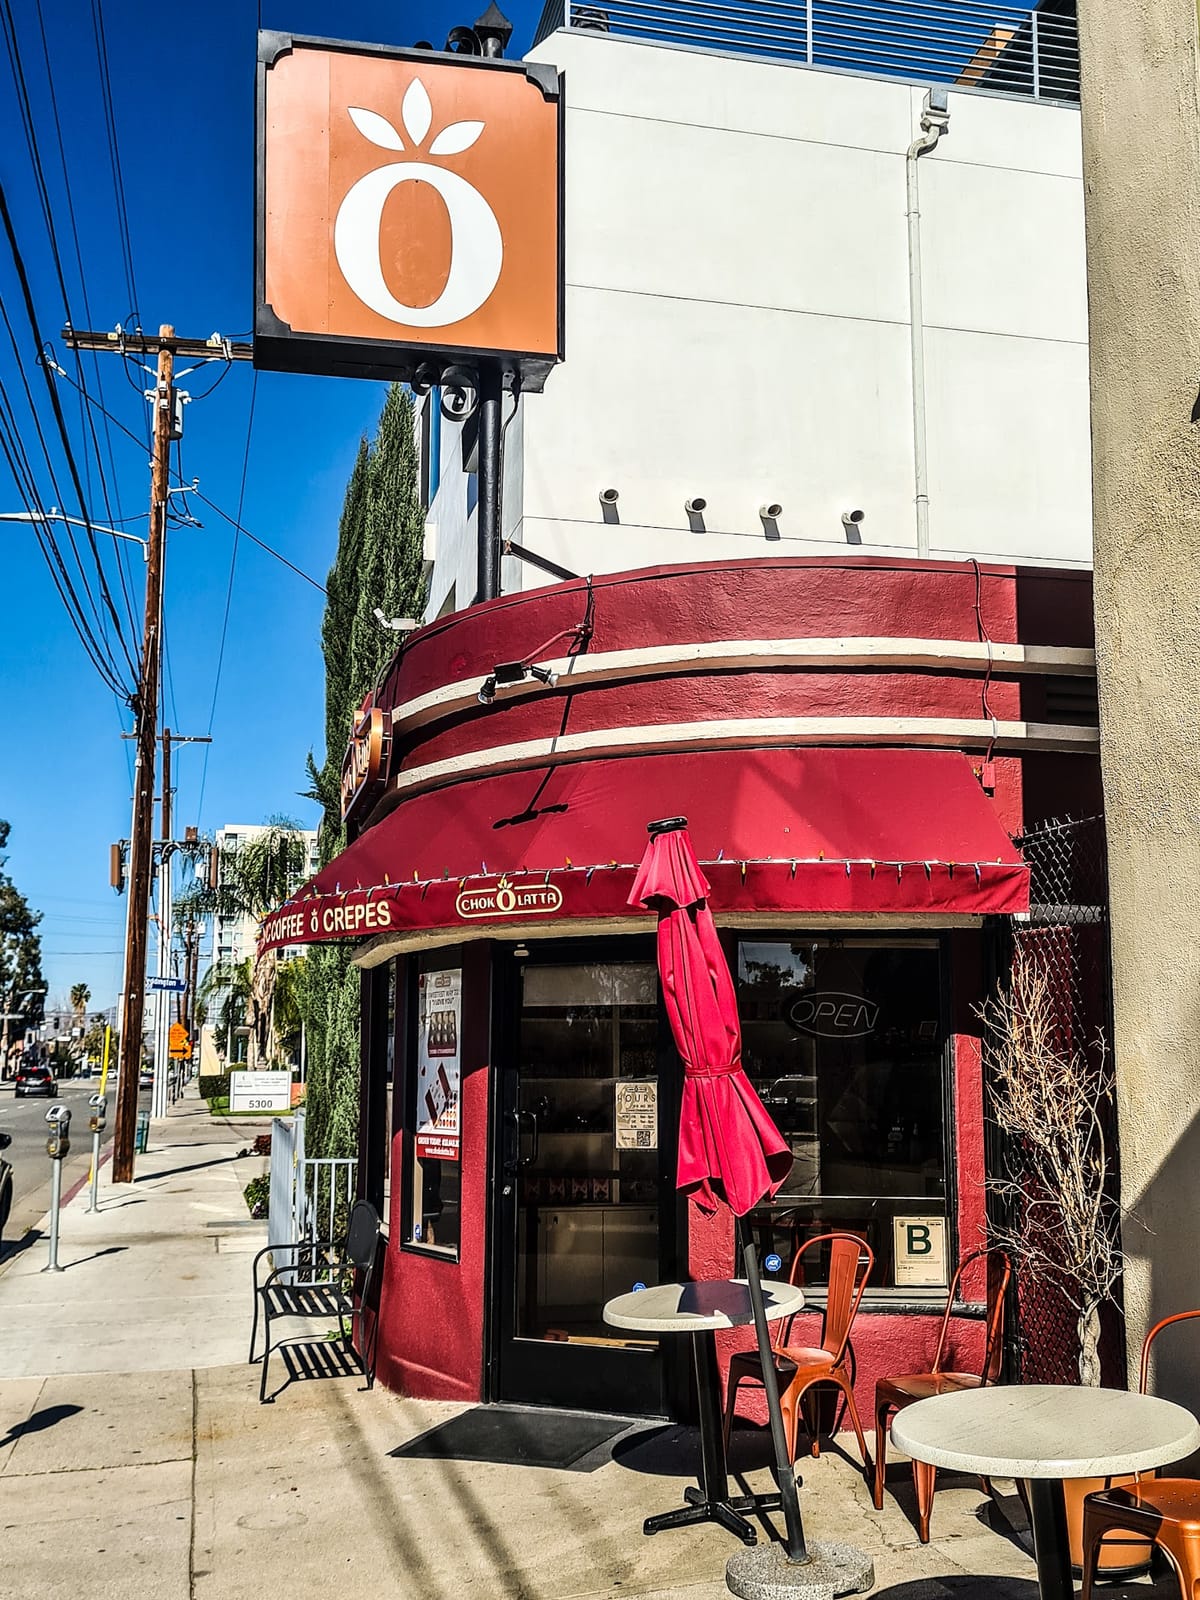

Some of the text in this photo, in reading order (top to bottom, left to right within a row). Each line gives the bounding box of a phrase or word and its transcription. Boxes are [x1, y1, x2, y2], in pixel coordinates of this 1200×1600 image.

[461, 888, 557, 912] CHOKOLATTA
[271, 912, 304, 941] COFFEE
[323, 900, 391, 932] CREPES
[790, 1000, 880, 1028] OPEN
[248, 1099, 273, 1109] 5300
[617, 1094, 656, 1103] HOURS
[907, 1225, 932, 1254] B
